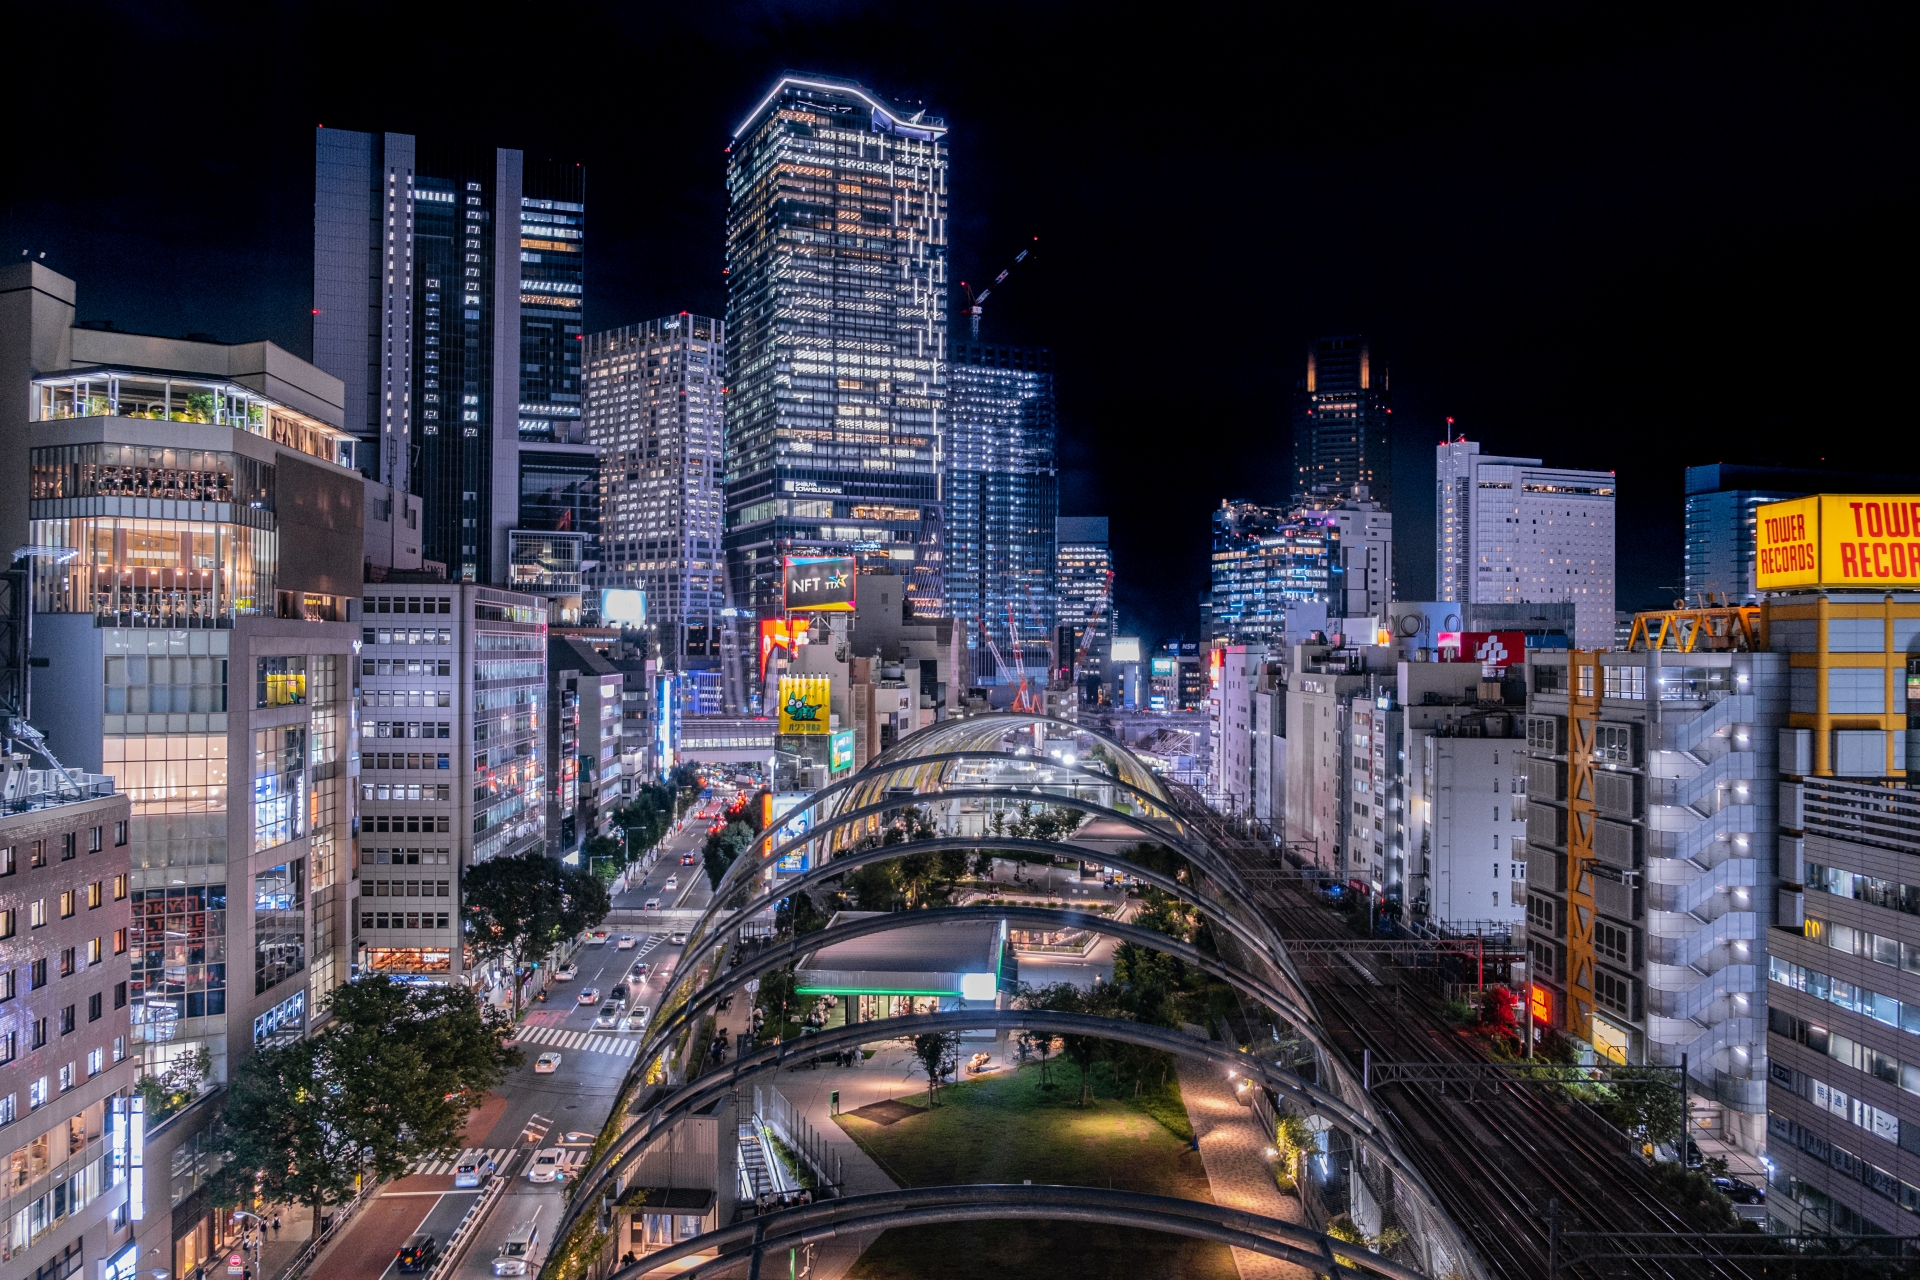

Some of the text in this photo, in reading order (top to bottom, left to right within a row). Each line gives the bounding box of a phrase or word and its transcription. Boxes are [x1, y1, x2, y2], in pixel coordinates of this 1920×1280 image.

[1765, 514, 1805, 544] TOWER
[1761, 543, 1814, 574] RECORDS
[792, 577, 840, 593] NFT TTX
